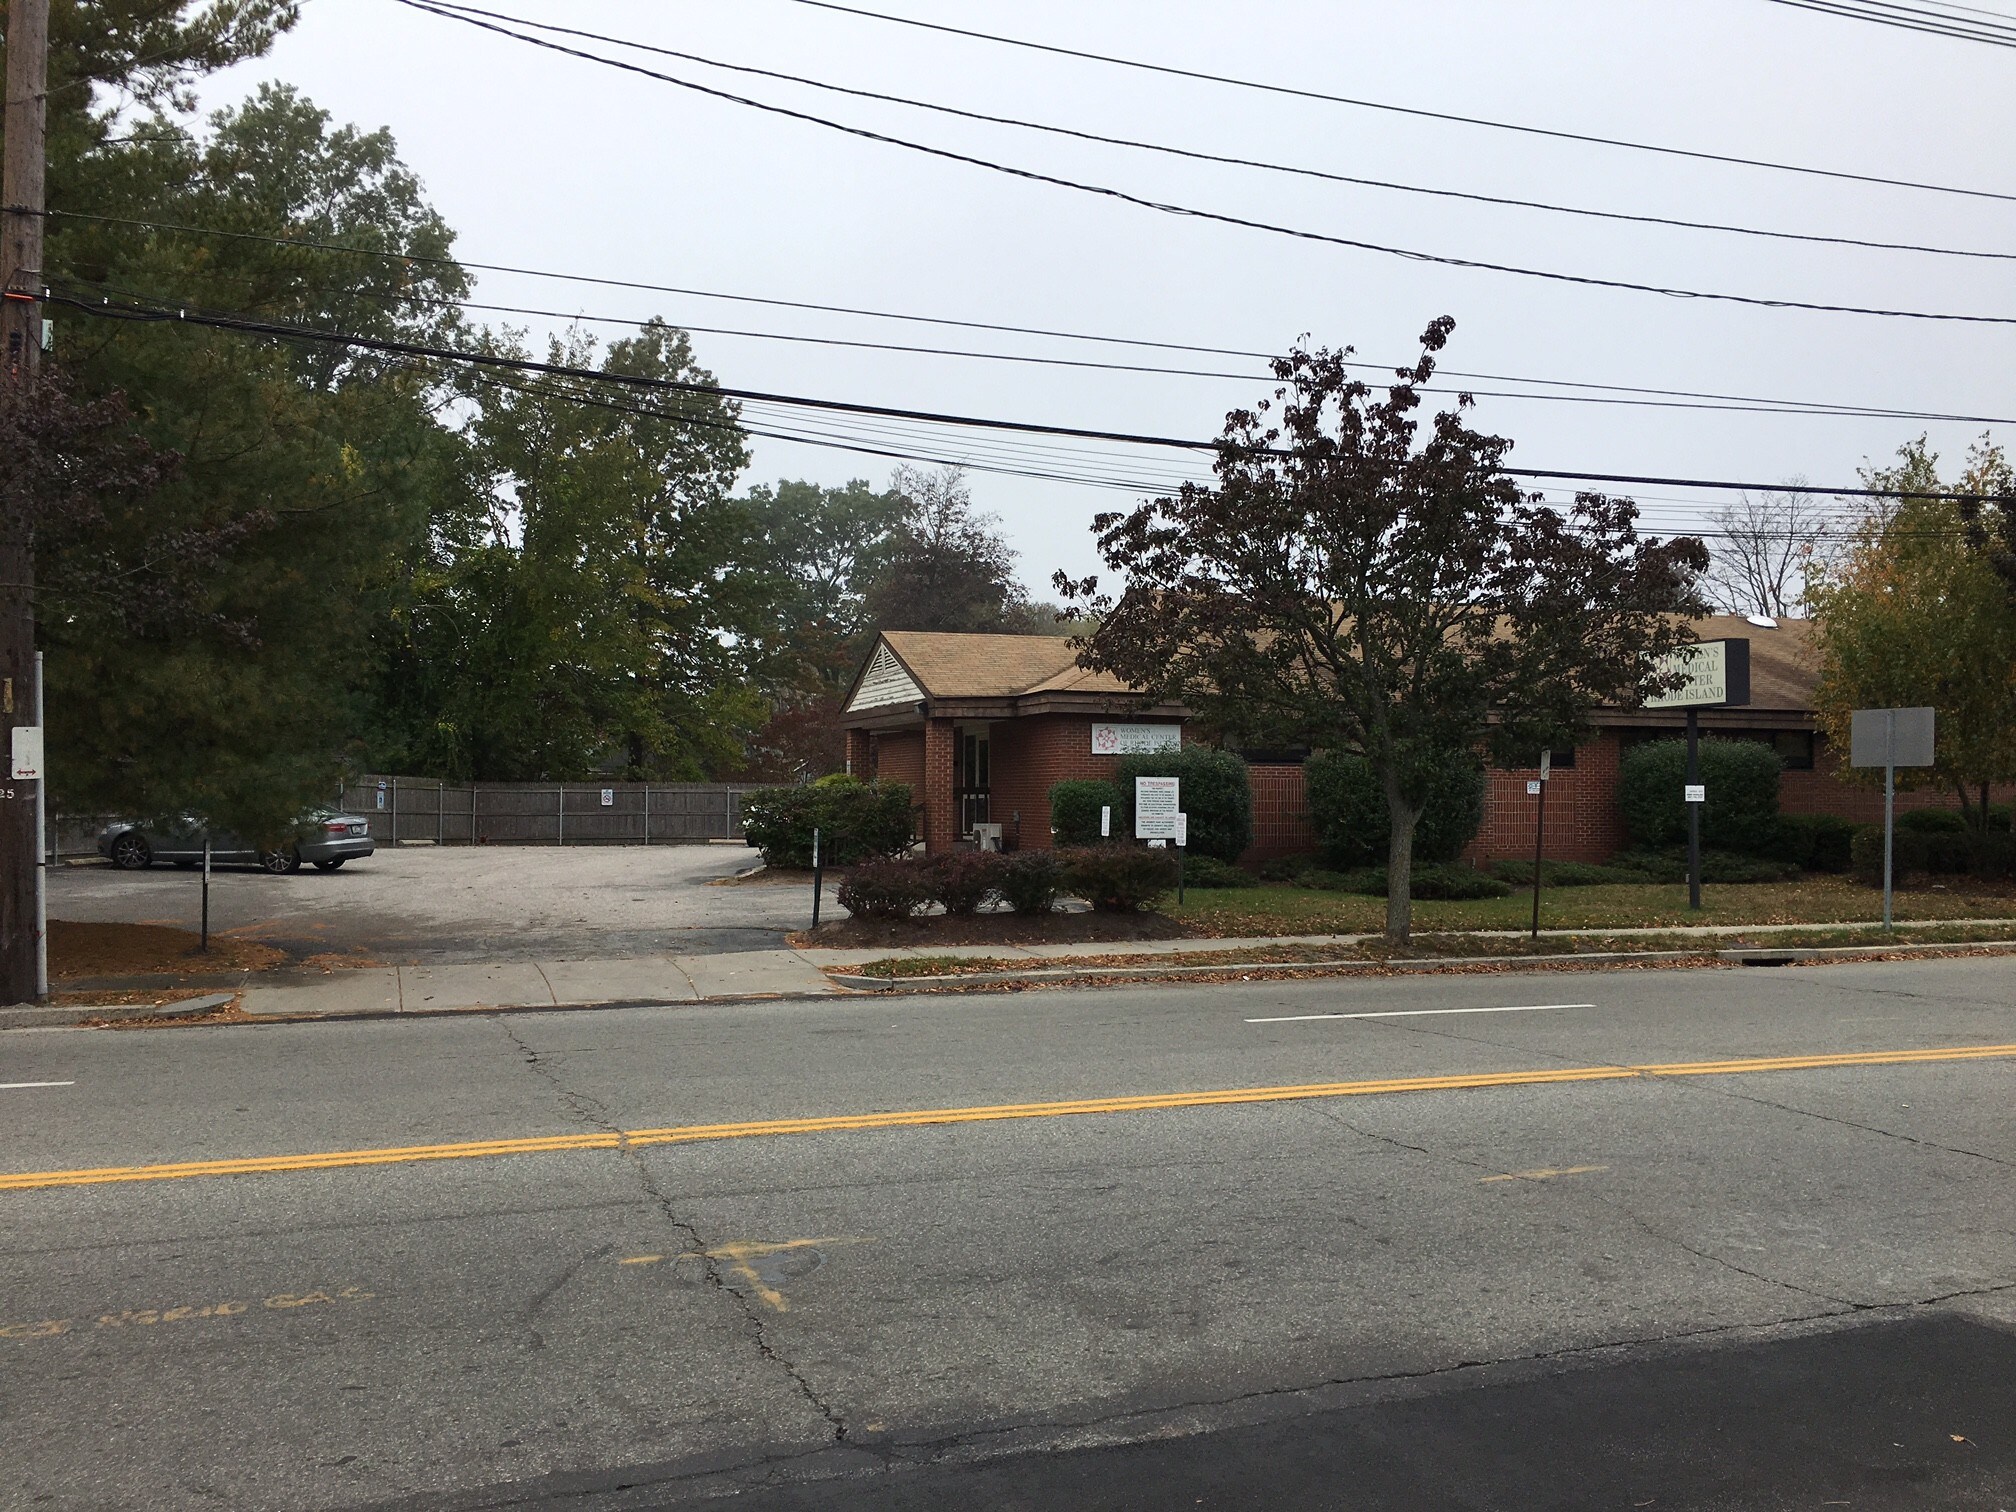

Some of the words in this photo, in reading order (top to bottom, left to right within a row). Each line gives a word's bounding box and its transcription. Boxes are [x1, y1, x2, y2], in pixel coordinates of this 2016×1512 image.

[1674, 647, 1719, 661] EN'S
[1673, 661, 1718, 674] MEDICAL
[1685, 686, 1724, 700] ISLAND
